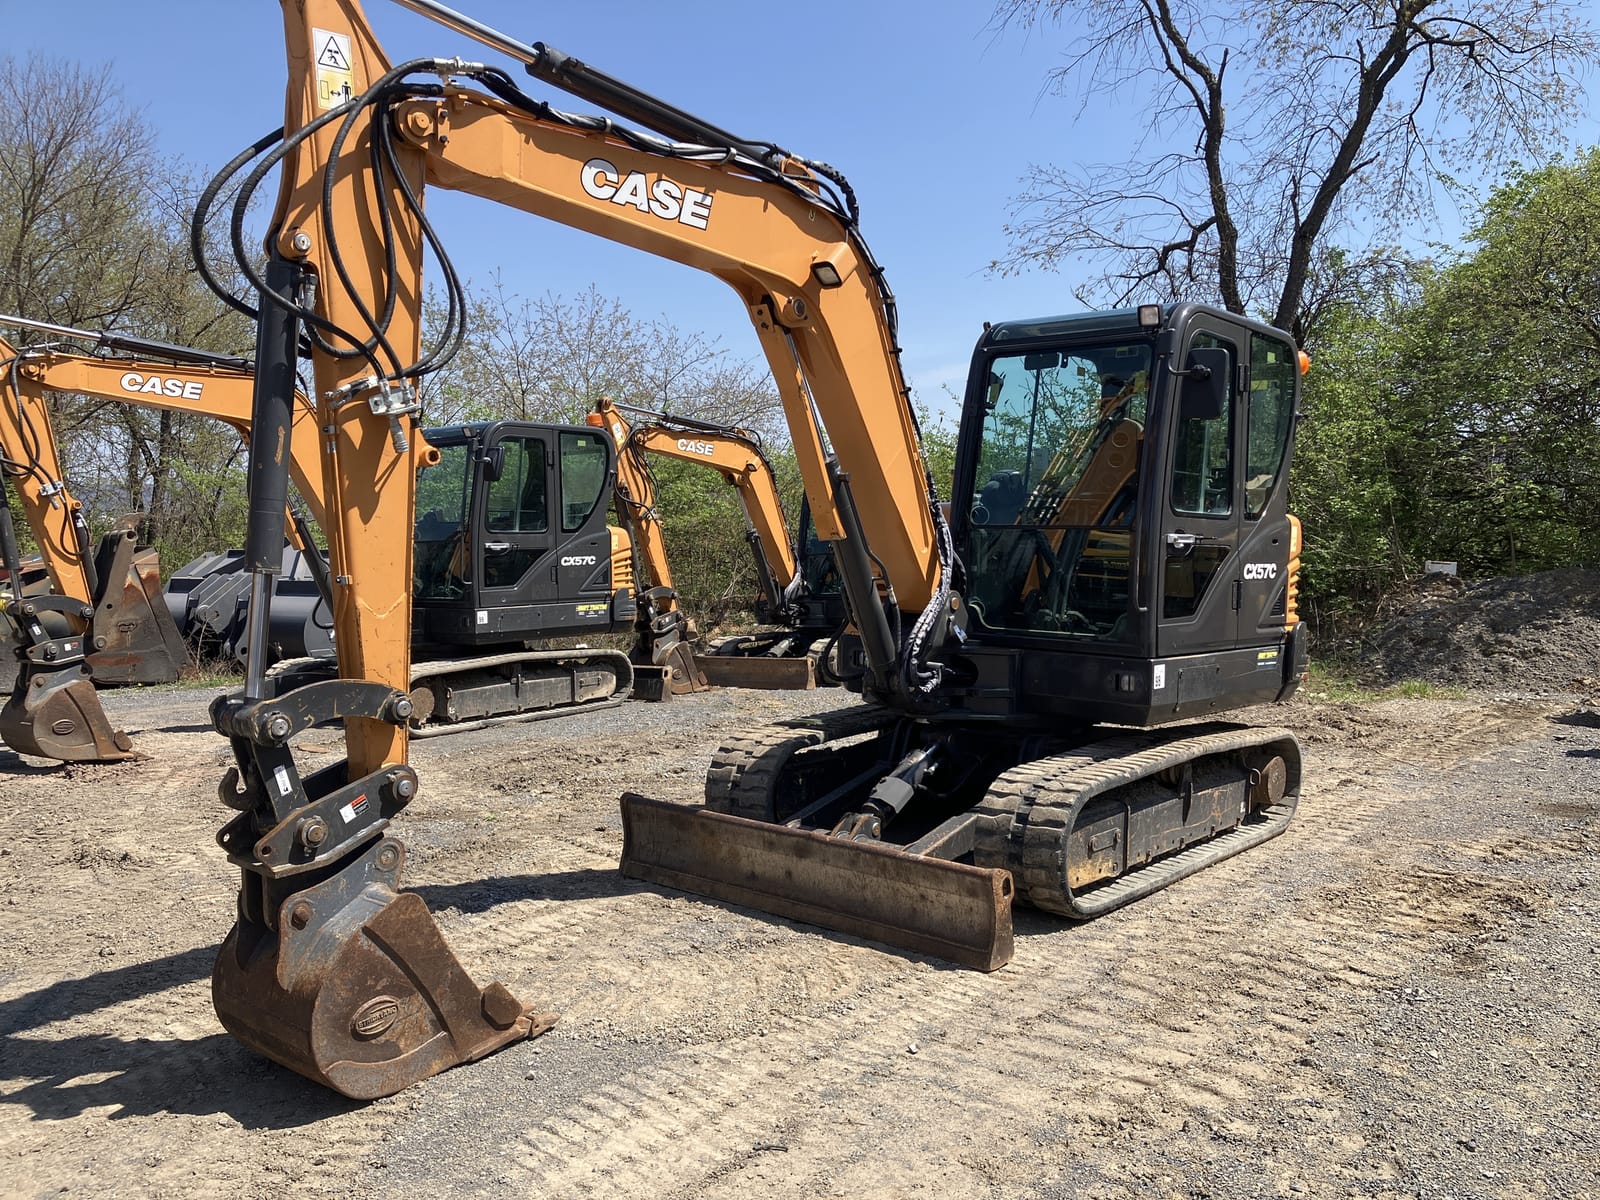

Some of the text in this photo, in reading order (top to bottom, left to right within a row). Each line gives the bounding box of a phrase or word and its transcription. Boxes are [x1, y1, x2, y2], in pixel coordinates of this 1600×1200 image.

[580, 157, 714, 231] CASE
[120, 372, 204, 400] CASE
[677, 438, 714, 456] CASE
[561, 555, 596, 566] CX57C
[1243, 563, 1277, 579] CX57C
